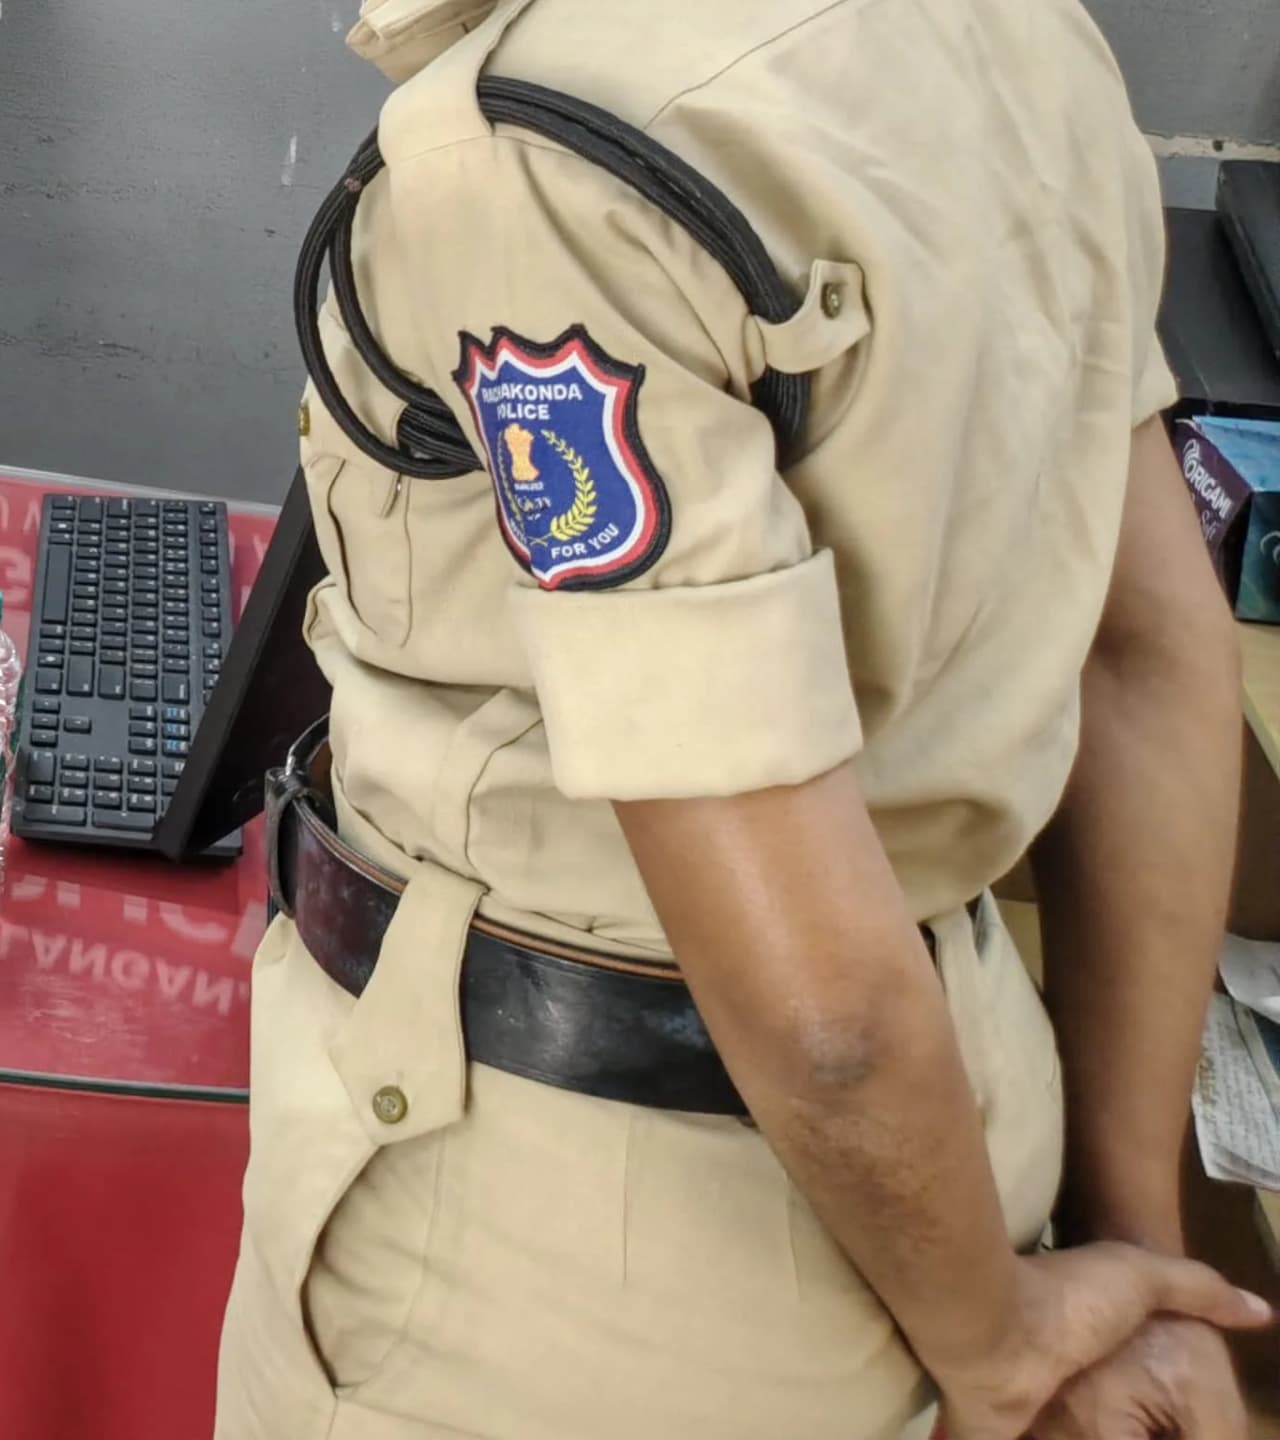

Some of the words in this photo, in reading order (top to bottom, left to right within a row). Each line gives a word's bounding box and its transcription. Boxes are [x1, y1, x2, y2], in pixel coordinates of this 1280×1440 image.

[1185, 461, 1233, 520] ORIGAMI
[552, 544, 587, 559] FOR
[590, 522, 620, 550] YOU
